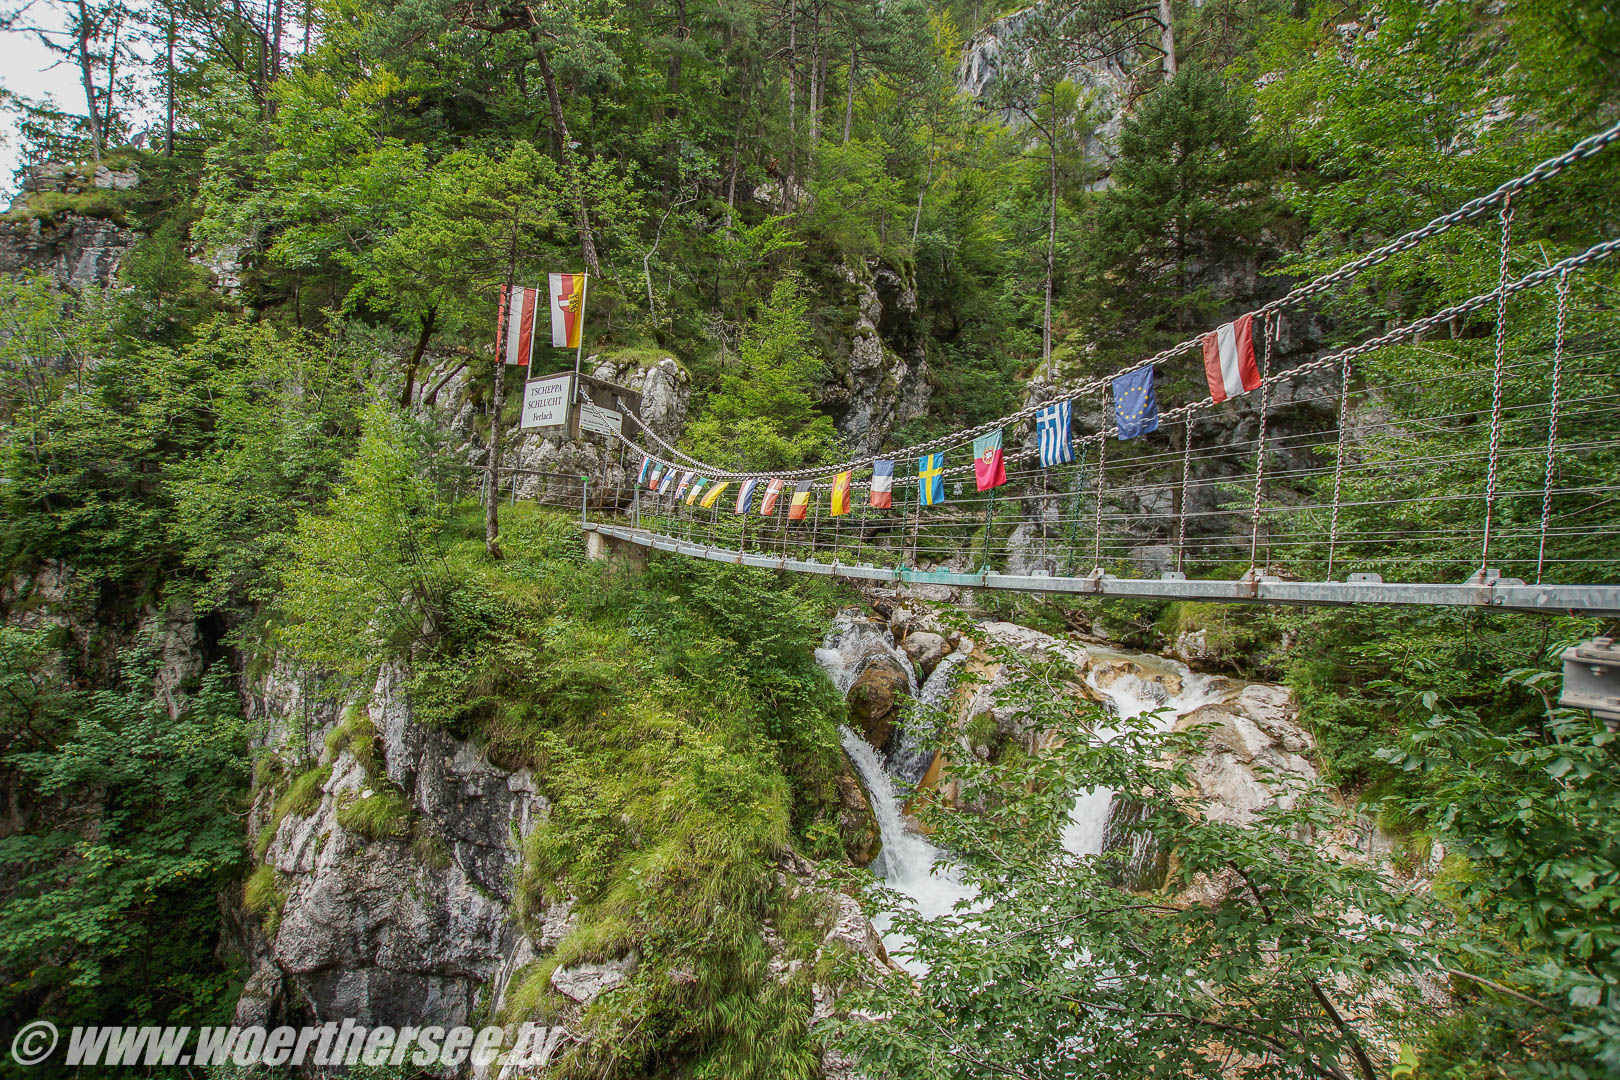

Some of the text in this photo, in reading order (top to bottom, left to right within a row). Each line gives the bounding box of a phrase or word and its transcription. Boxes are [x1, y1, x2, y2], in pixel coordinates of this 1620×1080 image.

[531, 384, 562, 396] TSCHEPPA
[528, 397, 562, 409] SCHLUCHT
[533, 411, 552, 421] Ferlach
